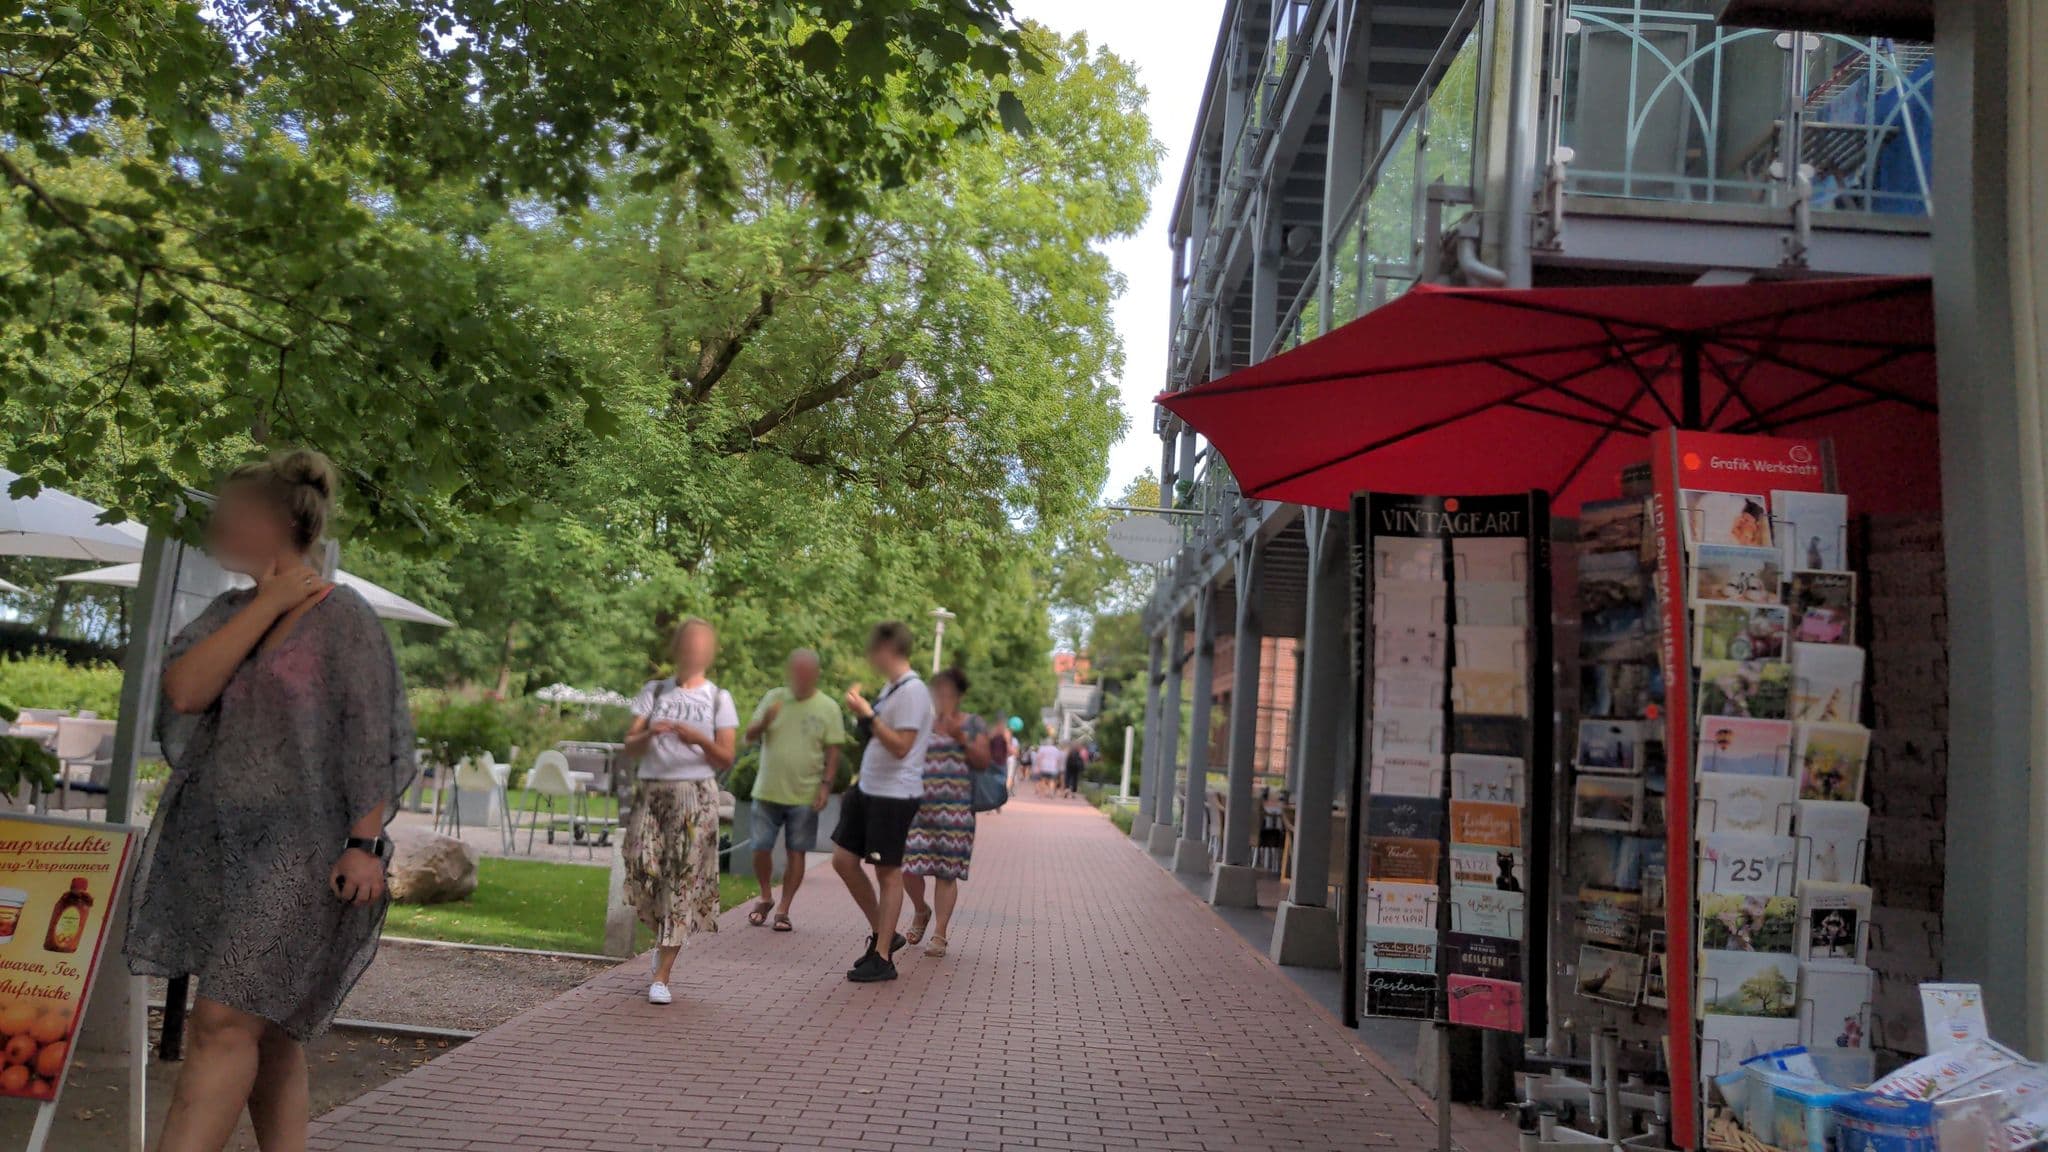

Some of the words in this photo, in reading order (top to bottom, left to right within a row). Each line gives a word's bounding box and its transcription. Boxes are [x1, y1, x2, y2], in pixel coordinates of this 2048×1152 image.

[1710, 455, 1750, 471] Grafik
[1754, 459, 1819, 476] Werkstatt
[1730, 858, 1764, 882] 25
